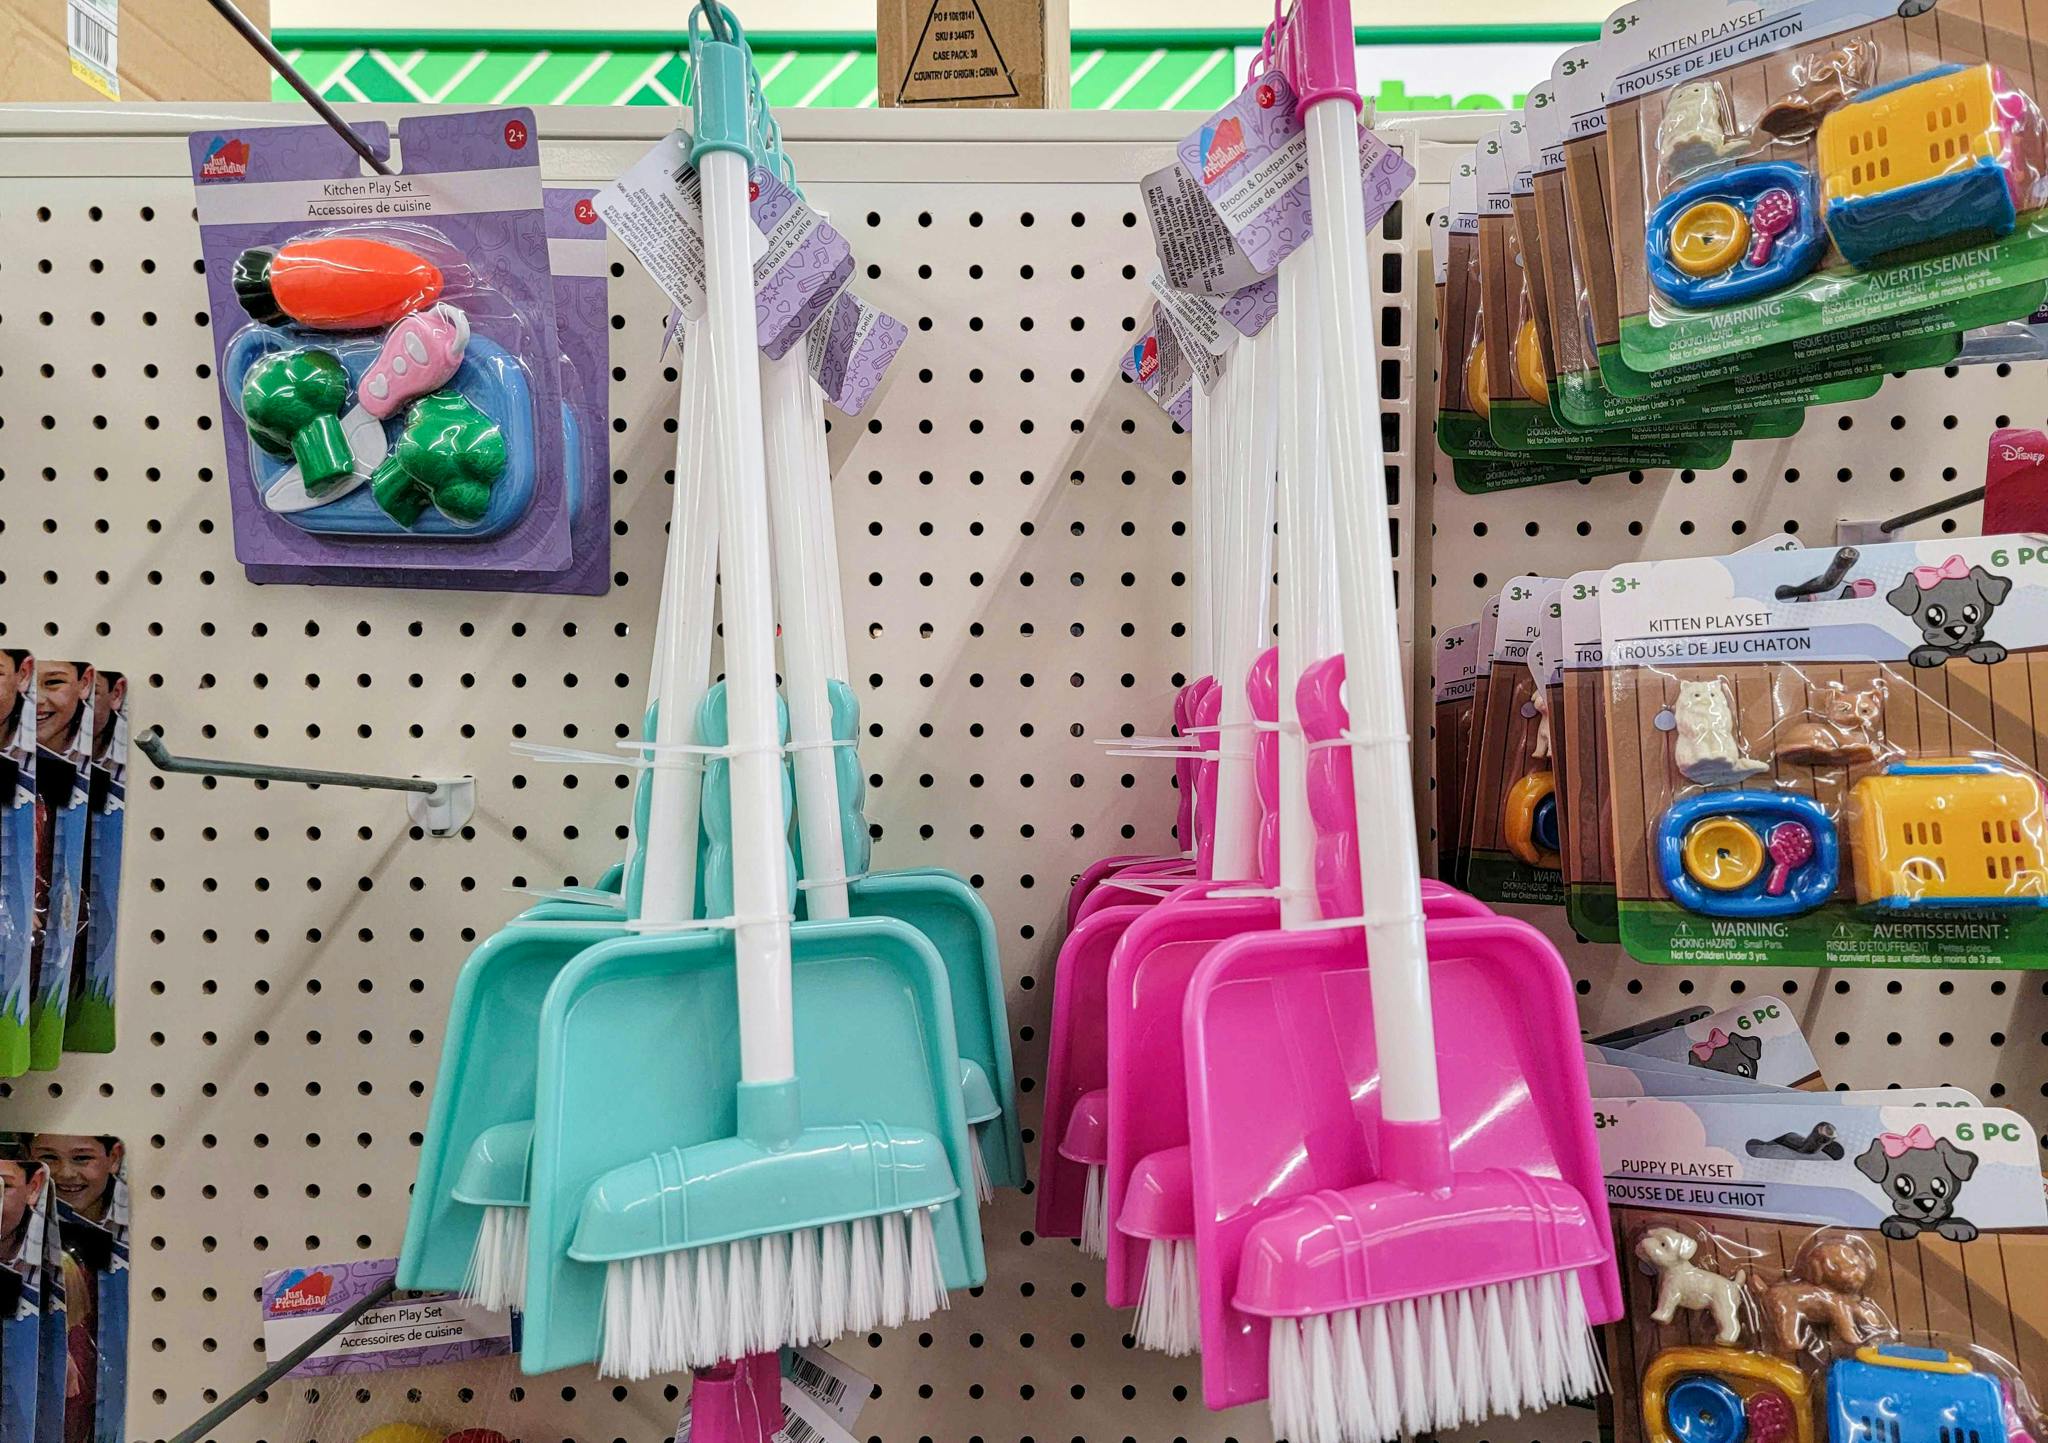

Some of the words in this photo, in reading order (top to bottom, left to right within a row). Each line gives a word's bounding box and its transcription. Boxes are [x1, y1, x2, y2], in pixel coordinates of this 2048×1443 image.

[934, 13, 942, 22] PO
[1612, 14, 1640, 35] 3+
[935, 32, 948, 41] SKU
[1648, 34, 1697, 62] KITTEN
[1701, 8, 1764, 42] PLAYSET
[933, 51, 950, 61] CASE
[951, 50, 970, 59] PACK:
[1617, 66, 1681, 96] TROUSSE
[1685, 57, 1704, 73] DE
[1707, 46, 1733, 65] JEU
[1738, 21, 1803, 53] CHATON
[914, 71, 943, 81] COUNTRY
[943, 70, 953, 79] OF
[953, 69, 975, 79] ORIGIN
[979, 67, 998, 77] CHINA
[1563, 58, 1589, 76] 3+
[508, 129, 524, 143] 2+
[1219, 186, 1249, 212] Broom
[1246, 179, 1256, 189] &
[1253, 152, 1291, 184] Dustpan
[1287, 136, 1309, 157] Play
[324, 183, 366, 197] Kitchen
[369, 181, 391, 196] Play
[394, 180, 413, 192] Set
[1177, 177, 1187, 198] VOLVO
[1231, 195, 1265, 224] Trousse
[1262, 186, 1276, 199] de
[1273, 168, 1297, 189] balai
[308, 203, 373, 216] Accessoires
[376, 202, 389, 213] de
[393, 200, 432, 212] cuisine
[624, 193, 642, 212] VOLVO
[638, 188, 671, 226] DISTRIBUTED
[1185, 179, 1201, 217] GREENBRIER
[579, 207, 594, 218] 2+
[631, 192, 662, 227] GREENBRIER
[1148, 189, 1158, 208] MADE
[1156, 217, 1166, 236] CHINA
[1160, 204, 1173, 232] IMPORTS
[1166, 196, 1180, 227] IMPORTED
[621, 212, 649, 242] IMPORTED
[777, 205, 805, 235] Playset
[621, 221, 645, 247] IMPORTS
[1176, 205, 1189, 231] CANADA
[1188, 245, 1200, 270] CANADA
[636, 218, 658, 244] CANADA
[666, 254, 688, 279] CANADA
[759, 269, 770, 281] de
[767, 248, 787, 269] balai
[786, 240, 794, 249] &
[794, 219, 812, 242] pelle
[601, 210, 618, 228] MADE
[623, 234, 641, 254] CHINA
[671, 290, 688, 309] CHINE
[1868, 246, 2001, 292] AVERTISSEMENT
[1929, 290, 1939, 299] de
[1941, 284, 1965, 297] moins
[1967, 281, 1977, 291] de
[861, 313, 874, 333] pelle
[1195, 315, 1204, 324] BC
[1206, 314, 1218, 326] PAR
[1709, 303, 1784, 330] WARNING:
[1193, 323, 1202, 332] EN
[1199, 329, 1215, 345] CHINE
[1669, 336, 1702, 352] CHOKING
[1703, 329, 1733, 344] HAZARD
[1805, 345, 1835, 357] convient
[1836, 343, 1850, 352] pas
[1864, 333, 1890, 345] enfants
[1891, 331, 1901, 340] de
[1902, 327, 1924, 338] moins
[1924, 325, 1934, 333] de
[1670, 351, 1681, 361] Not
[1683, 348, 1694, 358] for
[1694, 342, 1721, 355] Children
[1722, 337, 1744, 349] Under
[1651, 380, 1662, 389] Not
[1664, 378, 1672, 386] for
[1673, 372, 1700, 385] Children
[1701, 368, 1722, 379] Under
[1991, 549, 2010, 568] 6
[1510, 586, 1532, 601] 3+
[1573, 584, 1599, 600] 3+
[1611, 577, 1641, 594] 3+
[1650, 617, 1701, 633] KITTEN
[1706, 612, 1773, 629] PLAYSET
[1444, 636, 1464, 650] 3+
[1618, 643, 1683, 660] TROUSSE
[1688, 643, 1708, 656] DE
[1712, 640, 1738, 655] JEU
[1743, 636, 1811, 653] CHATON
[1711, 922, 1789, 938] WARNING:
[1873, 924, 2001, 939] AVERTISSEMENT
[1670, 938, 1704, 949] CHOKING
[1706, 938, 1736, 949] HAZARD
[1743, 939, 1763, 949] Small
[1826, 941, 1858, 952] RISQUE
[1670, 951, 1684, 960] Not
[1684, 951, 1694, 960] for
[1695, 950, 1725, 960] Children
[1726, 951, 1747, 960] Under
[1748, 951, 1754, 960] 3
[1755, 952, 1768, 962] yrs.
[1826, 952, 1838, 962] Ne
[1839, 952, 1870, 963] convient
[1871, 954, 1886, 964] pas
[1887, 954, 1901, 963] aux
[1903, 953, 1930, 963] enfants
[1932, 954, 1942, 963] de
[1944, 954, 1966, 964] moins
[1968, 954, 1978, 964] de
[1979, 954, 1986, 964] 3
[1987, 955, 2003, 964] ans.
[1737, 1015, 1751, 1031] 6
[1753, 1004, 1781, 1025] PC
[1594, 1112, 1619, 1129] 3+
[1955, 1122, 1974, 1141] 6
[1982, 1122, 2021, 1142] PC
[1621, 1159, 1666, 1175] PUPPY
[1671, 1163, 1734, 1178] PLAYSET
[1606, 1183, 1662, 1201] ROUSSE
[1665, 1188, 1684, 1202] DE
[1689, 1190, 1714, 1204] JEU
[1718, 1191, 1765, 1207] CHIOT
[275, 1294, 328, 1309] Pretending
[284, 1288, 303, 1299] Just
[398, 1309, 422, 1325] Play
[424, 1306, 443, 1319] Set
[340, 1331, 405, 1348] Accessoires
[407, 1329, 422, 1340] de
[424, 1324, 463, 1339] cuisine
